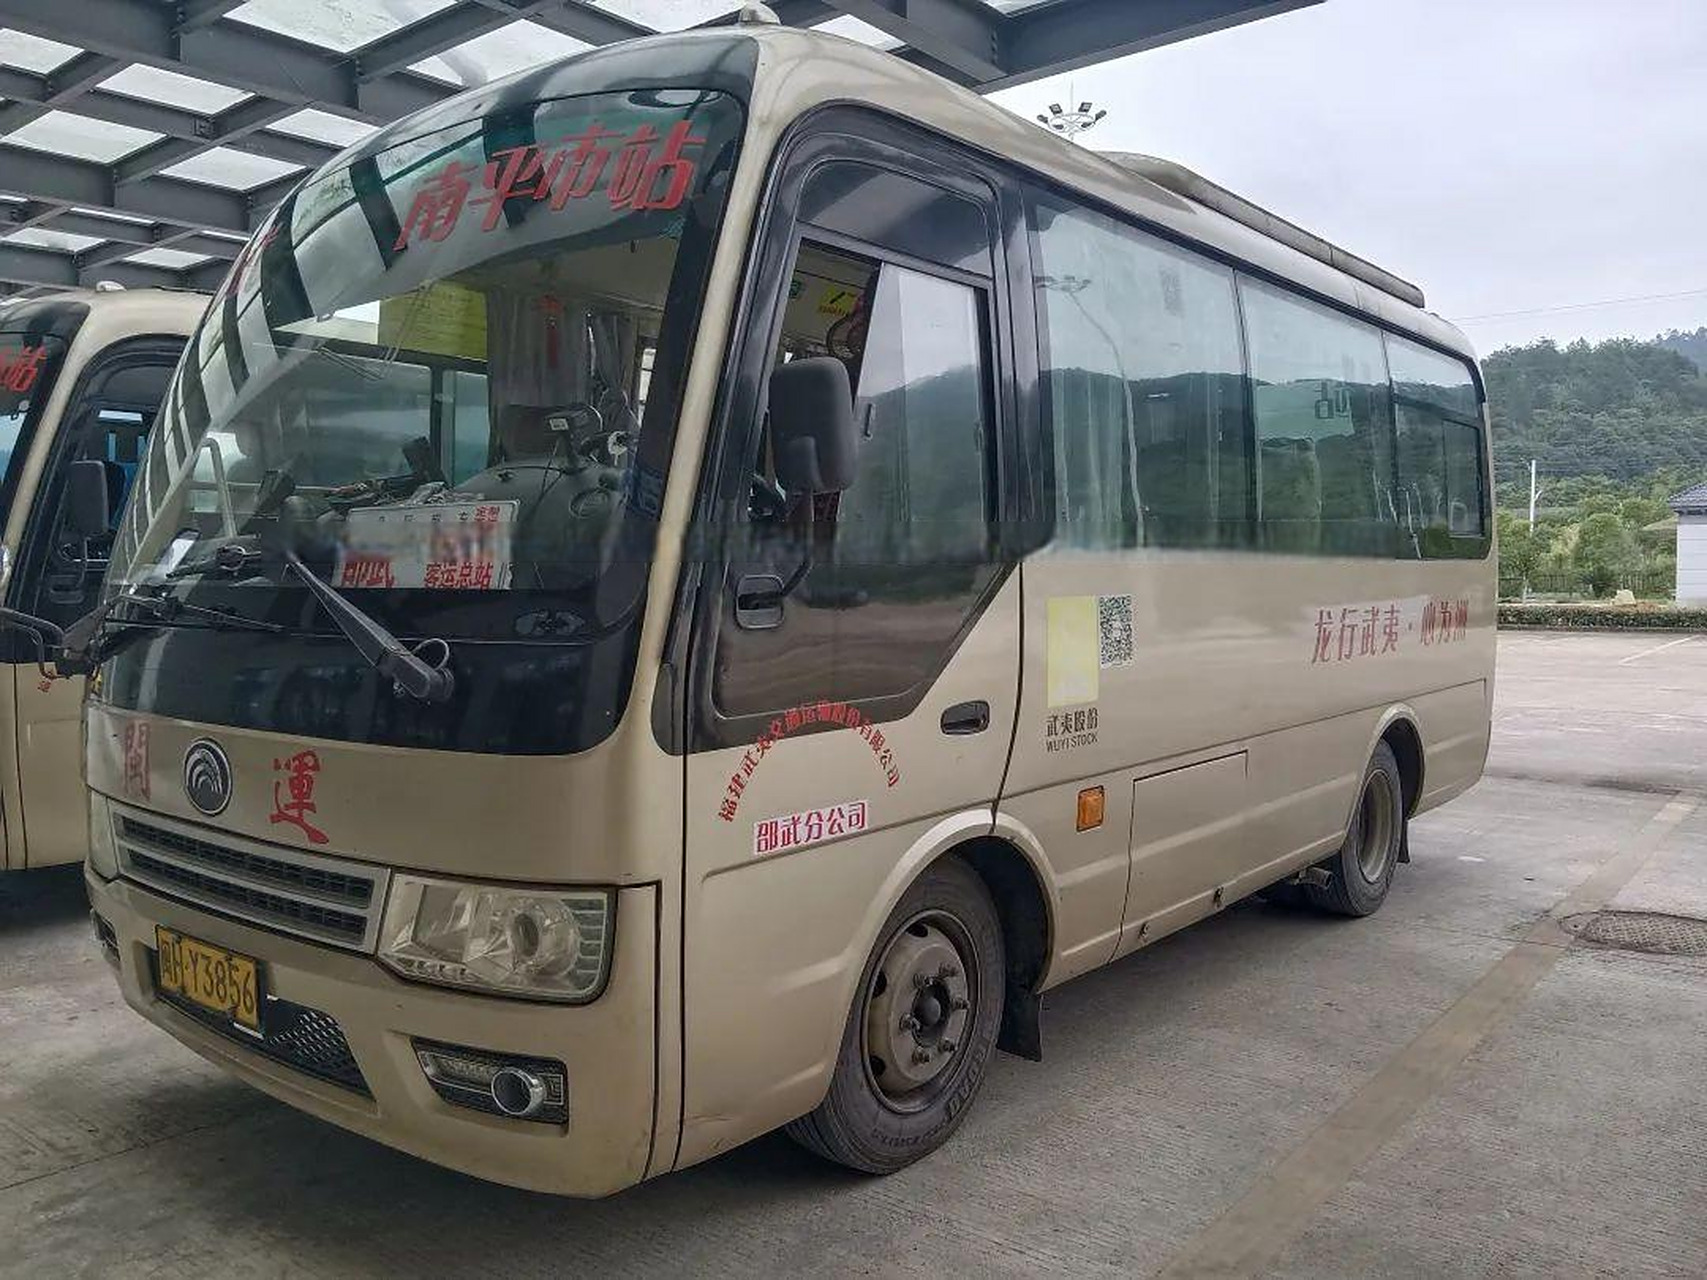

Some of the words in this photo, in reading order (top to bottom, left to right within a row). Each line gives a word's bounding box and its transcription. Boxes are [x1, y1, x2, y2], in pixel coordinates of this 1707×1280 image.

[392, 120, 707, 252] 南平市站
[424, 561, 494, 588] 客运总站
[1046, 707, 1099, 738] 武夷股份
[1046, 736, 1070, 752] WUYI
[1071, 732, 1098, 750] STOCK
[756, 802, 867, 852] 邵武分公司
